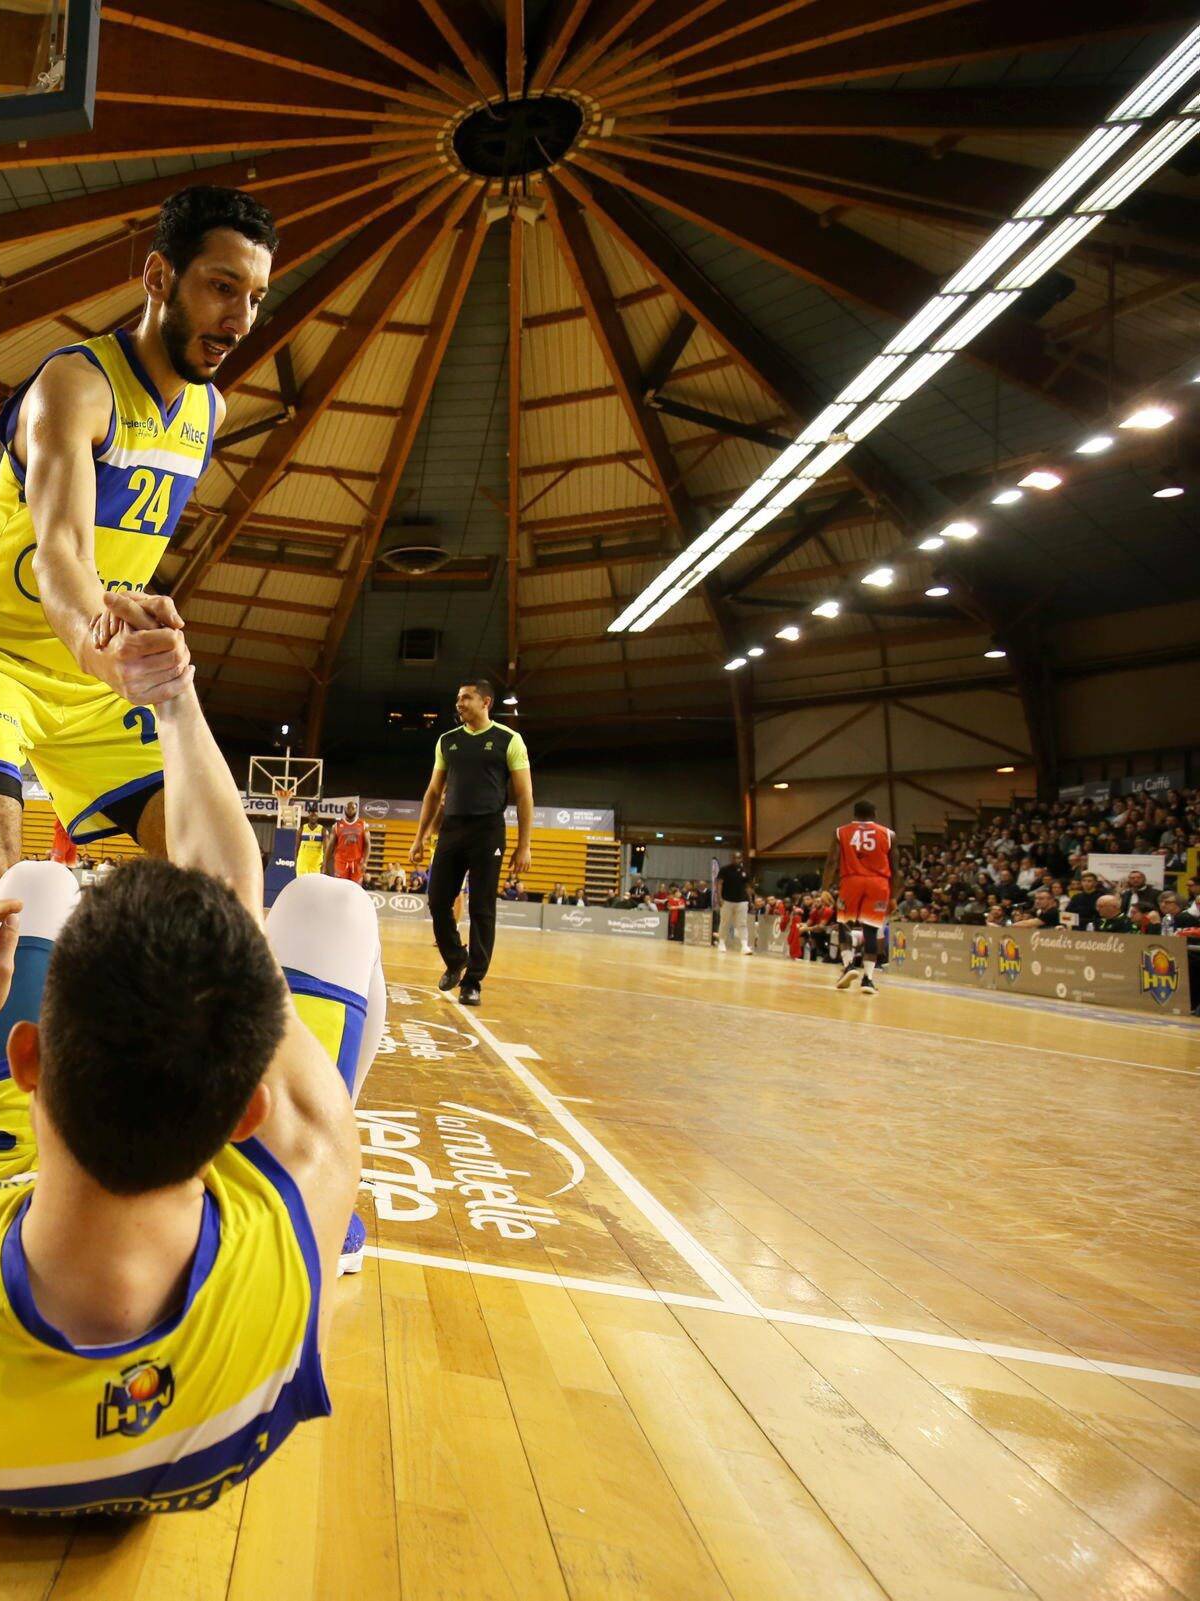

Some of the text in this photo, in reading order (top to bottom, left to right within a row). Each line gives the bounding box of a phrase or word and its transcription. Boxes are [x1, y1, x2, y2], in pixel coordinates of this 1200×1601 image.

[119, 468, 175, 533] 24
[850, 830, 876, 851] 45
[275, 858, 295, 868] Jeep
[395, 897, 418, 909] KIA
[1030, 931, 1126, 953] Grandir ensemble
[999, 956, 1022, 973] HTV
[1141, 968, 1179, 990] HTV
